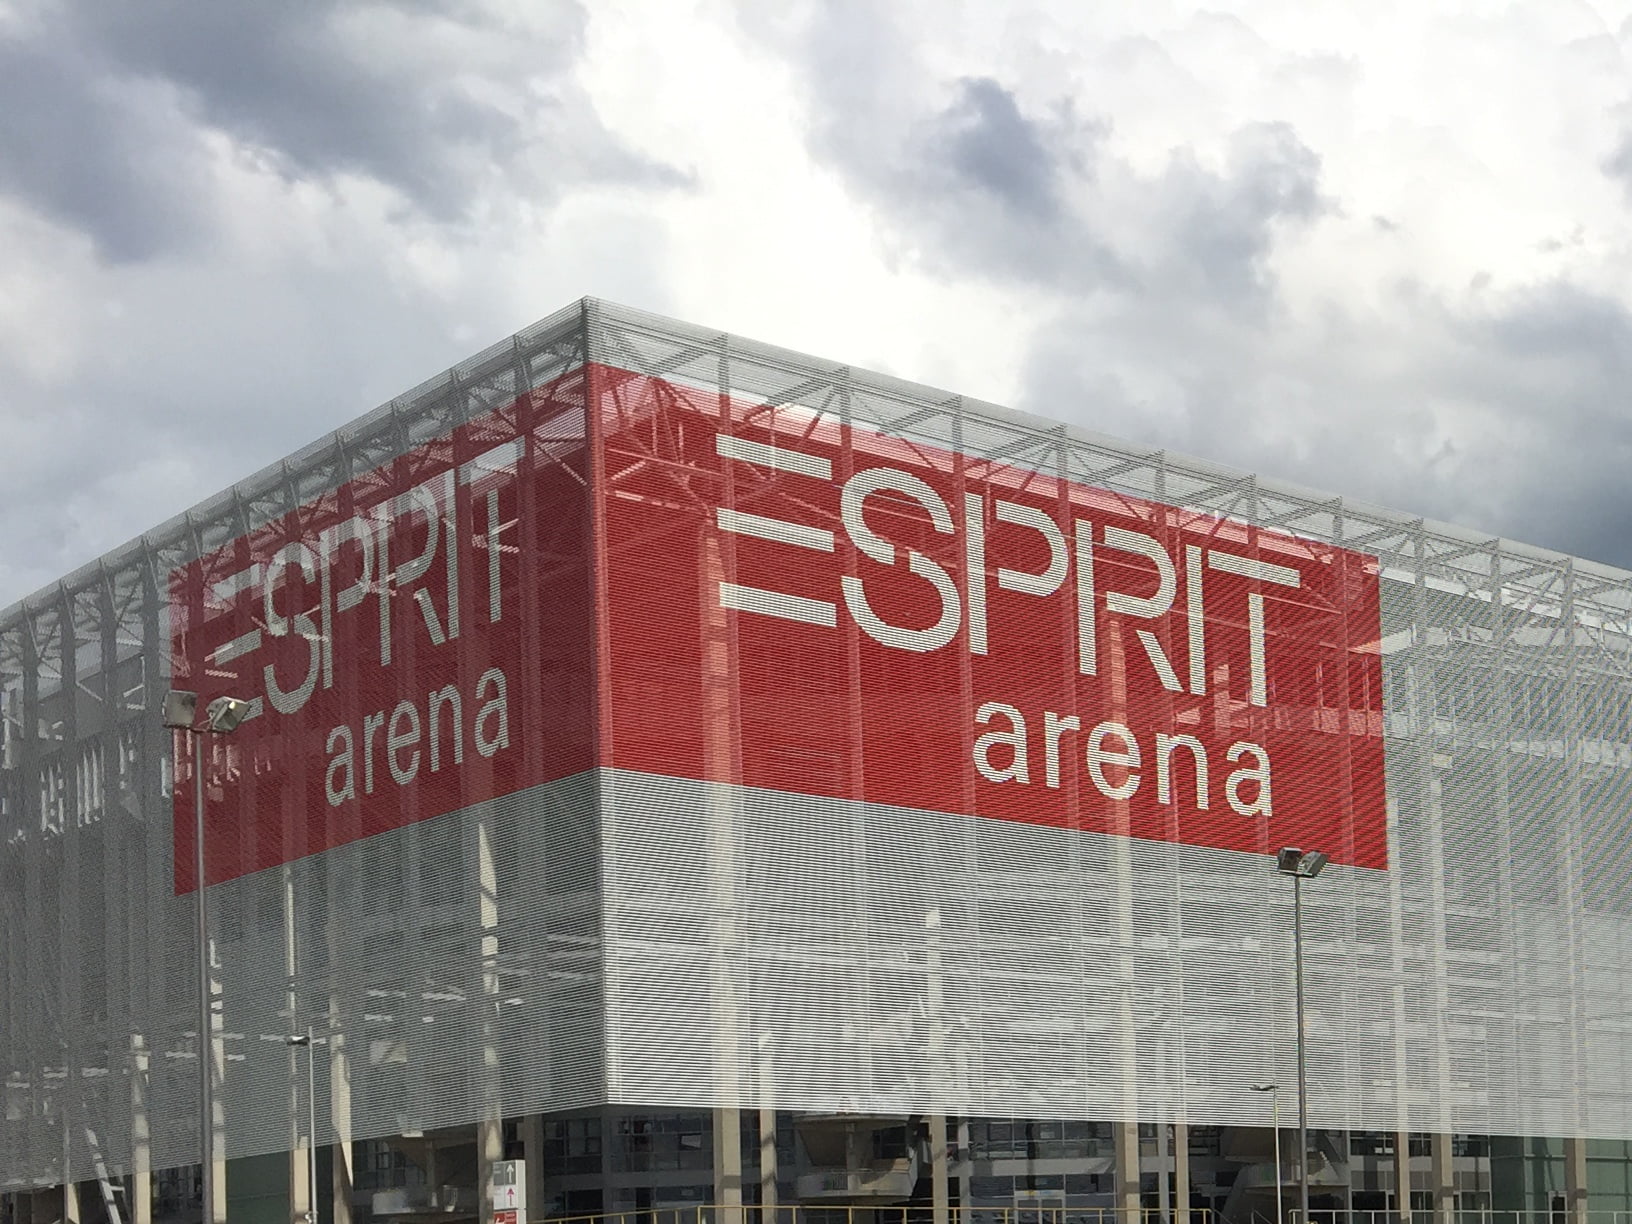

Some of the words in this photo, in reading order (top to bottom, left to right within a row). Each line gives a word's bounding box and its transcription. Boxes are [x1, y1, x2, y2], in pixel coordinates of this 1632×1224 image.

[212, 437, 527, 723] ESPRIT
[715, 433, 1301, 708] ESPRIT
[324, 666, 511, 808] arena
[972, 700, 1274, 818] arena
